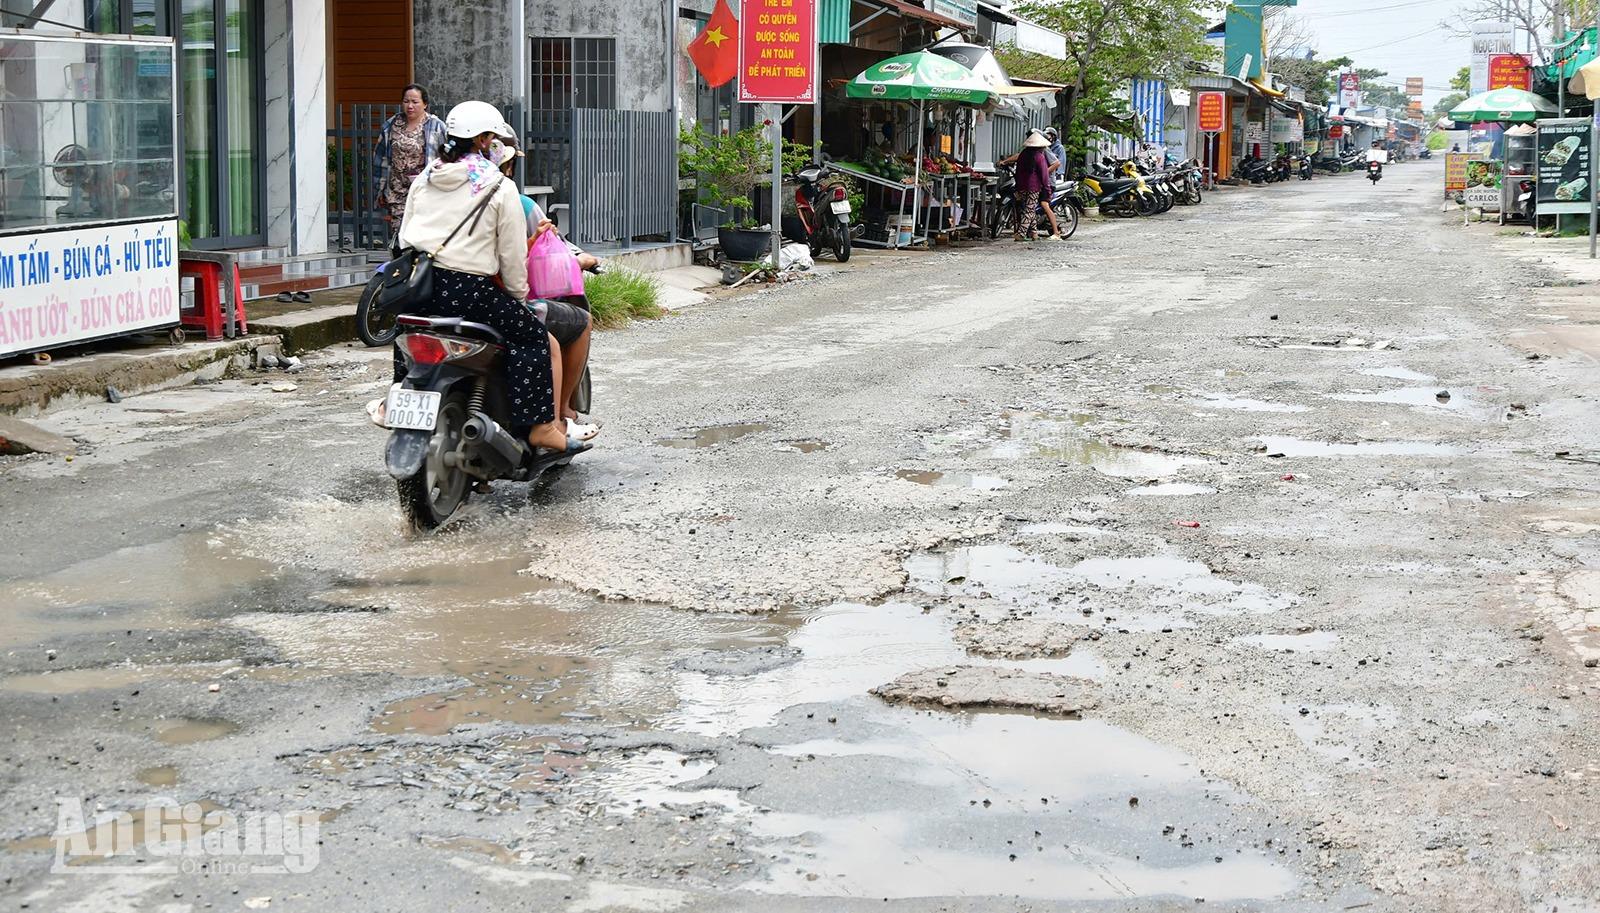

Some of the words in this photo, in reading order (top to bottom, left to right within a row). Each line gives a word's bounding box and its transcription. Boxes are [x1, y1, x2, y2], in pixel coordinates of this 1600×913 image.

[759, 11, 770, 25] CÓ
[771, 10, 798, 25] QUYỀN
[755, 30, 777, 45] ĐƯỢC
[780, 28, 800, 43] SỐNG
[761, 49, 772, 59] AN
[773, 46, 795, 60] TOÀN
[748, 61, 759, 77] ĐỂ
[761, 64, 783, 77] PHÁT
[784, 62, 806, 78] TRIỂN
[1468, 194, 1499, 202] CARLOS
[18, 238, 50, 287] TẤM
[63, 238, 91, 281] BÚN
[95, 235, 112, 277] CÁ
[124, 228, 141, 273] HỦ
[145, 225, 172, 270] TIẾU
[37, 294, 69, 338] ƯỚT
[80, 287, 112, 331] BÚN
[116, 276, 145, 325] CHẢ
[149, 277, 172, 319] GIÒ
[396, 393, 432, 410] 59-X1
[389, 410, 434, 427] 000.76
